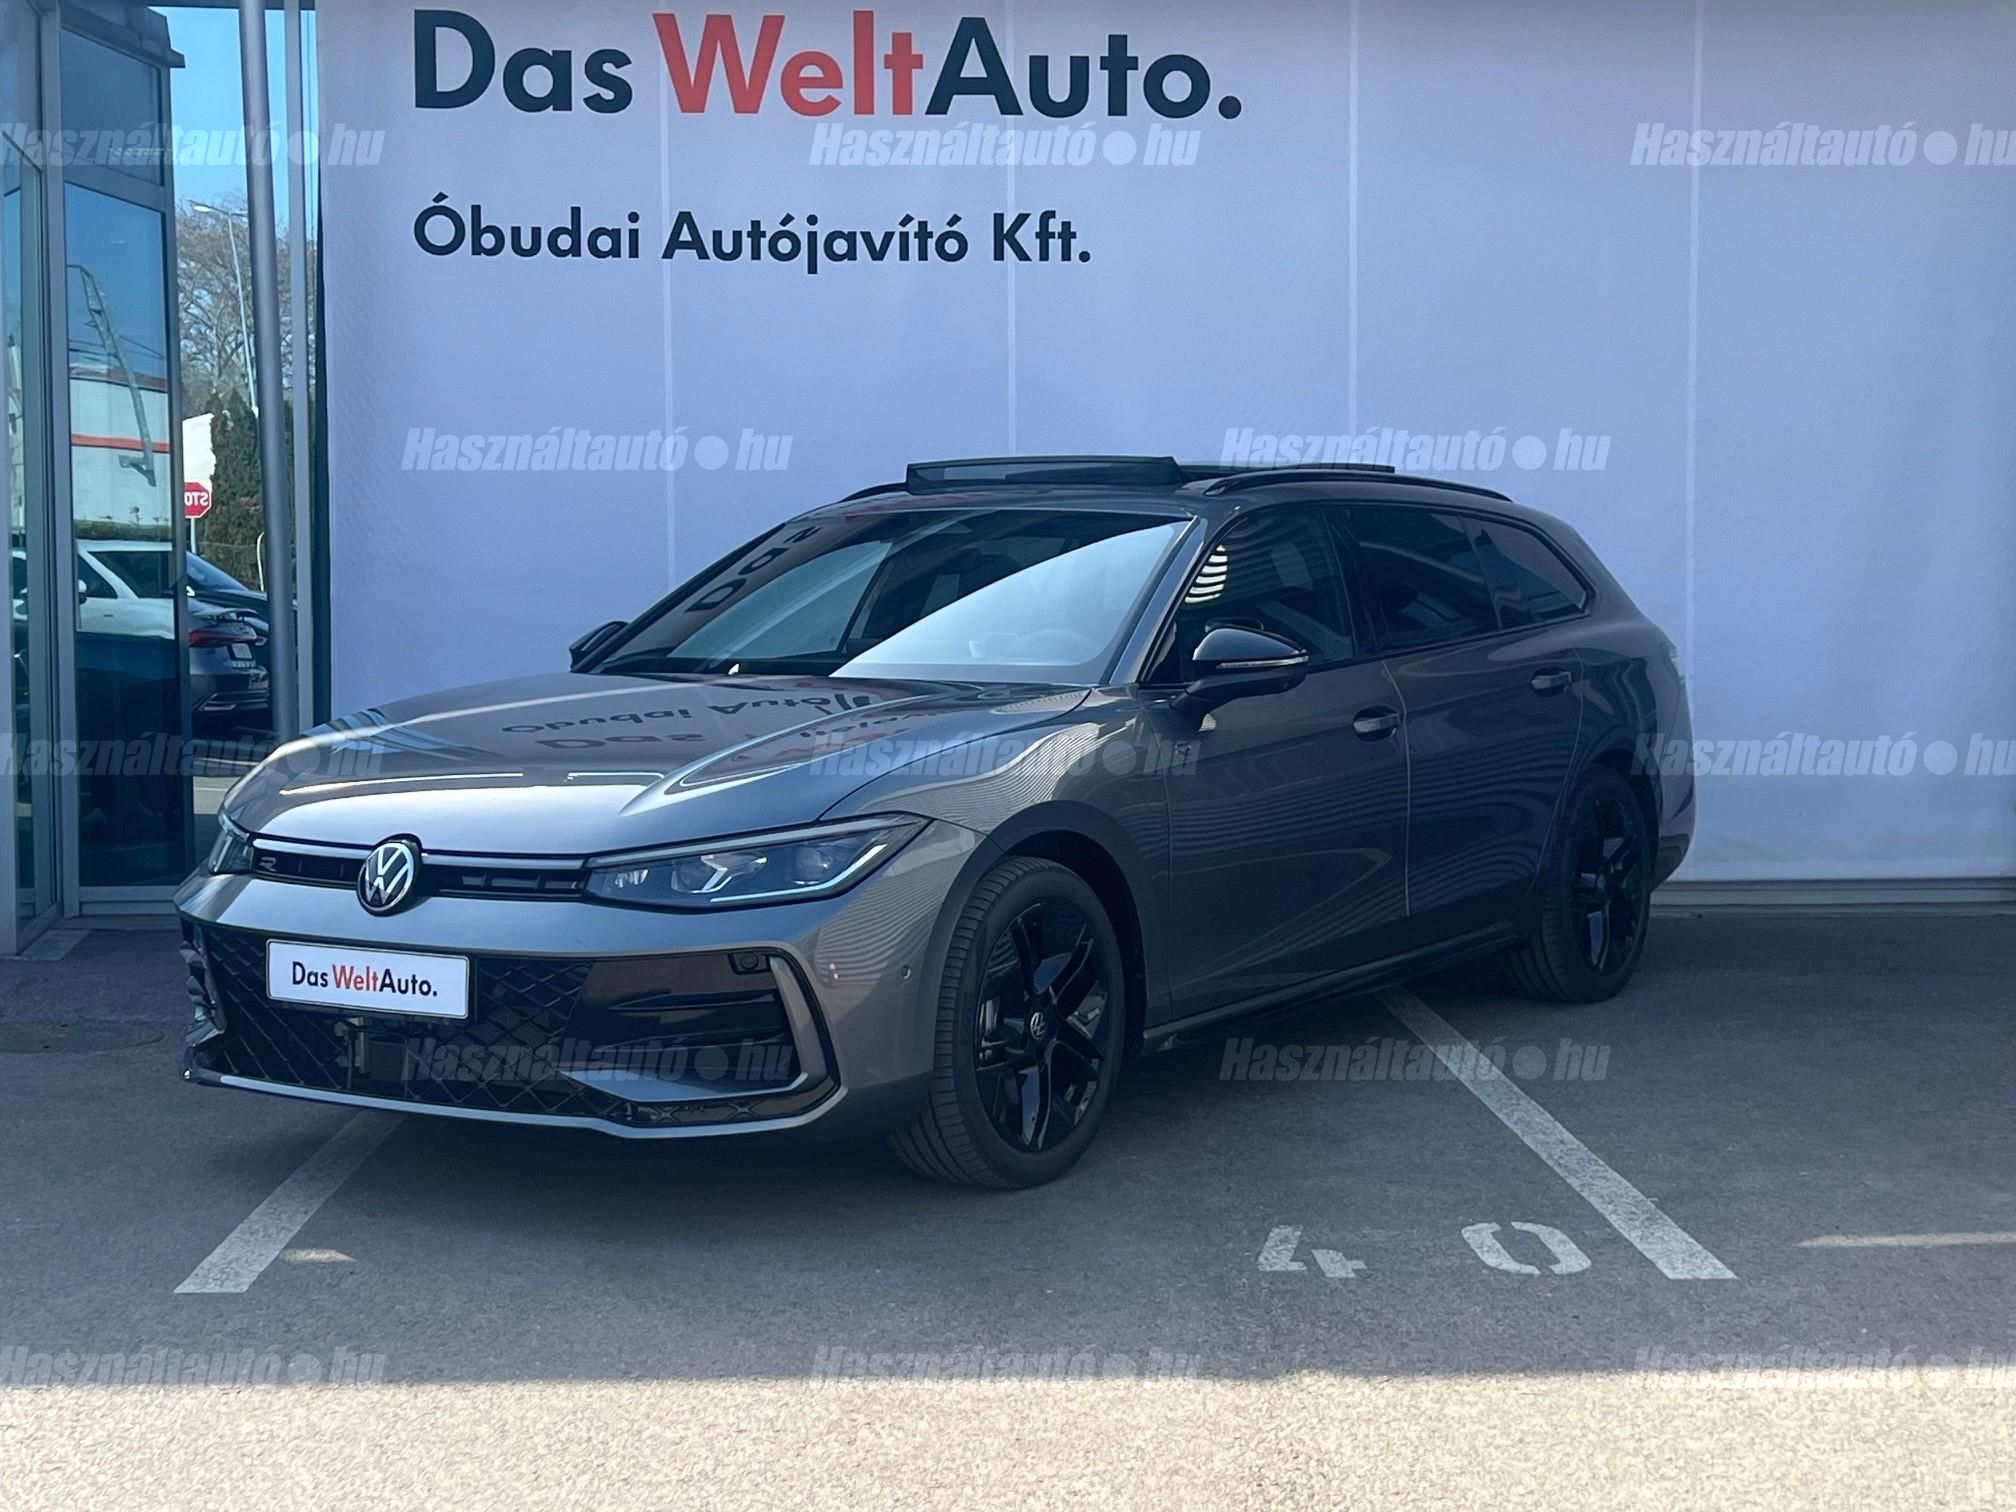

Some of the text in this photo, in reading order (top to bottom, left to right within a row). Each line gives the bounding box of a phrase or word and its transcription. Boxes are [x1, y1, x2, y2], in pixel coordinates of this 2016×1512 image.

[413, 9, 1242, 119] Das WeltAuto.
[413, 191, 1092, 275] Óbudai Autójavító Kft.
[292, 961, 438, 997] Das WeltAuto.
